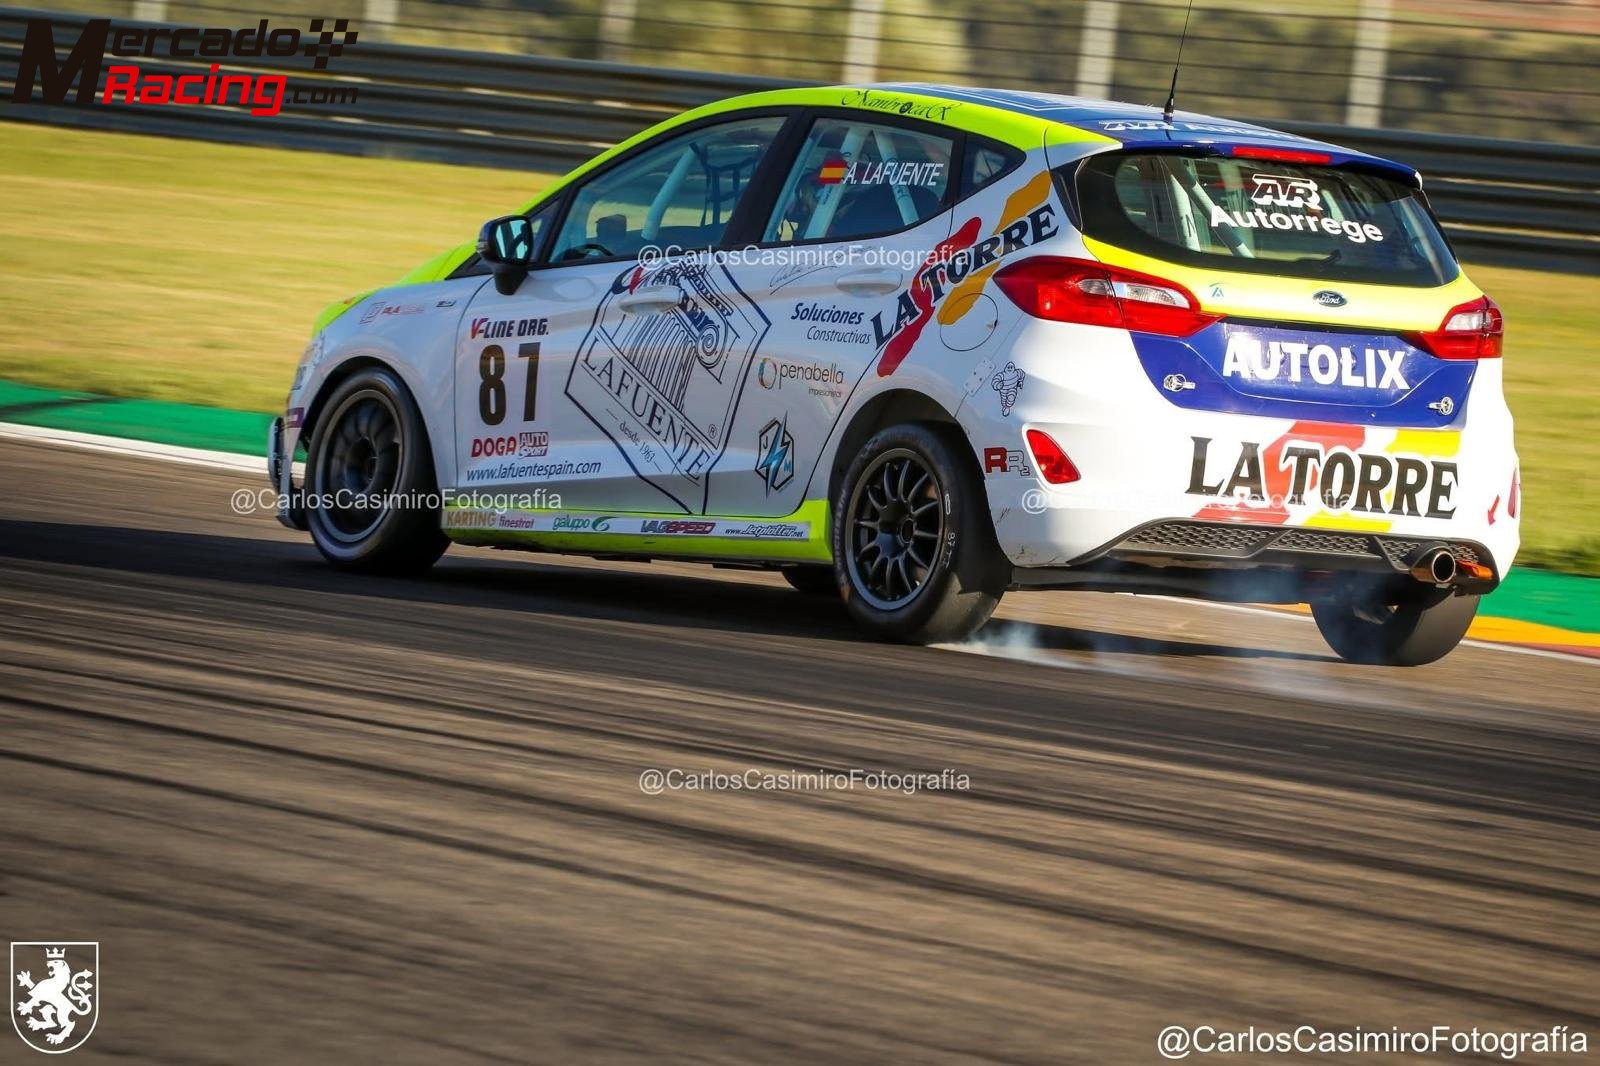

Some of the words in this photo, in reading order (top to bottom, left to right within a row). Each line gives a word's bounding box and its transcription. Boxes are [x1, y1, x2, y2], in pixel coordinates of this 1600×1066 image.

[844, 162, 857, 185] A.
[861, 162, 945, 186] LAFUENTE
[1211, 205, 1384, 243] Autorrege
[870, 289, 922, 350] LA
[920, 203, 1060, 303] TORRE
[791, 302, 865, 325] Soluciones
[471, 317, 515, 339] V-LINE
[807, 325, 872, 345] Constructivas
[1222, 333, 1410, 390] AUTOLIX
[583, 336, 711, 481] LAFUENTE
[471, 436, 517, 458] DOGA
[519, 432, 548, 446] AUTO
[466, 460, 602, 480] www.lafuentespain.com
[1185, 435, 1266, 502] LA
[1280, 446, 1459, 520] TORRE
[447, 511, 497, 528] KARTING
